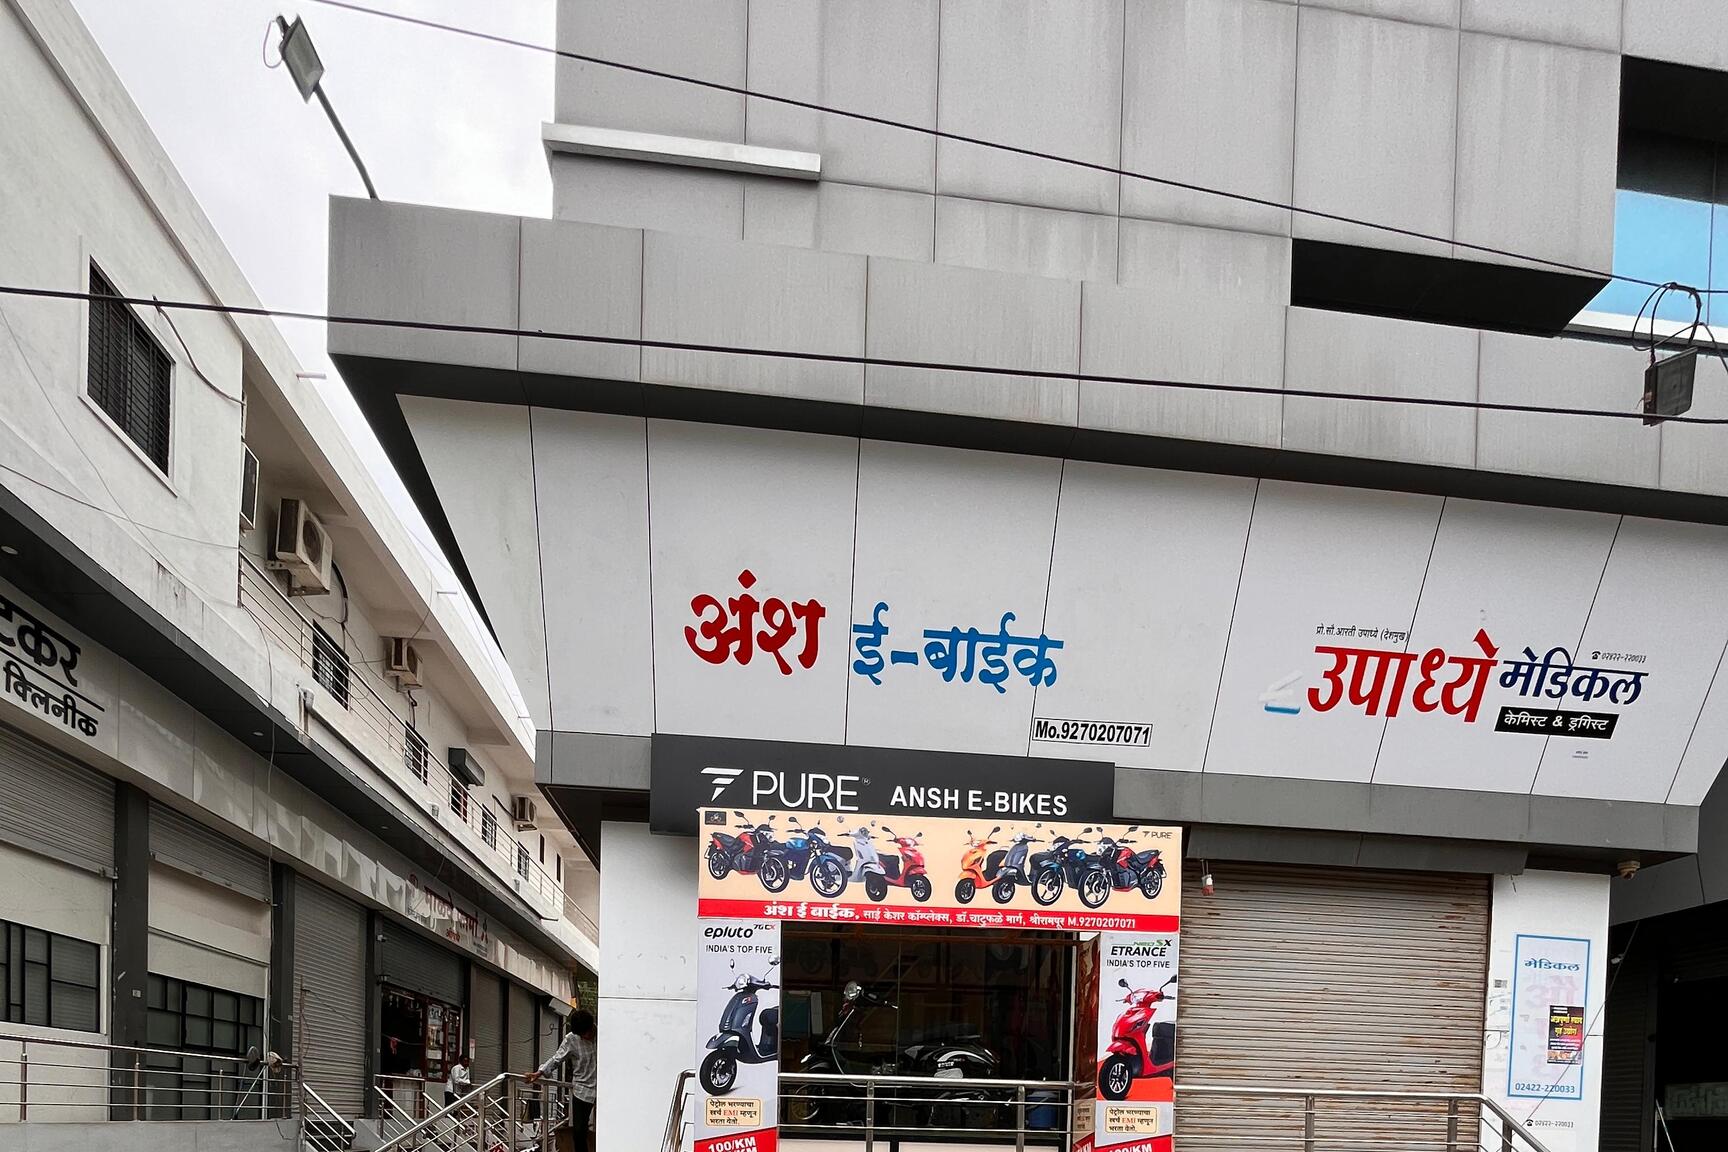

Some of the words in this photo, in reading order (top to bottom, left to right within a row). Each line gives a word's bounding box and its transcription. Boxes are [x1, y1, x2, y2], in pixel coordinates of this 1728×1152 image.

[683, 568, 827, 676] अंश
[852, 601, 1065, 695] ई-बाईक
[1306, 627, 1500, 724] उपाध्ये
[1499, 646, 1649, 705] मेडिकल
[1503, 709, 1549, 727] केमिस्ट
[1551, 715, 1564, 727] &
[1034, 719, 1152, 746] Mo.9270207071
[752, 769, 860, 812] PURE
[890, 785, 960, 812] ANSH
[967, 789, 1069, 817] E-BIKES
[1151, 831, 1173, 840] PURE
[763, 901, 794, 917] अंश
[796, 900, 809, 919] ई
[862, 908, 881, 921] साई
[882, 909, 905, 921] केशर
[1005, 912, 1026, 926] मार्ग,
[1067, 915, 1136, 929] M.9270207071
[704, 925, 754, 939] epluto
[705, 944, 735, 953] INDIA'S
[737, 945, 753, 954] TOP
[755, 945, 773, 954] FIVE
[1110, 946, 1167, 957] ETRANCE
[1106, 959, 1135, 968] INDIA'S
[1136, 960, 1152, 968] TOP
[1153, 960, 1170, 969] FIVE
[1524, 957, 1580, 972] मेडिकल
[1514, 1081, 1576, 1094] 02422-220033
